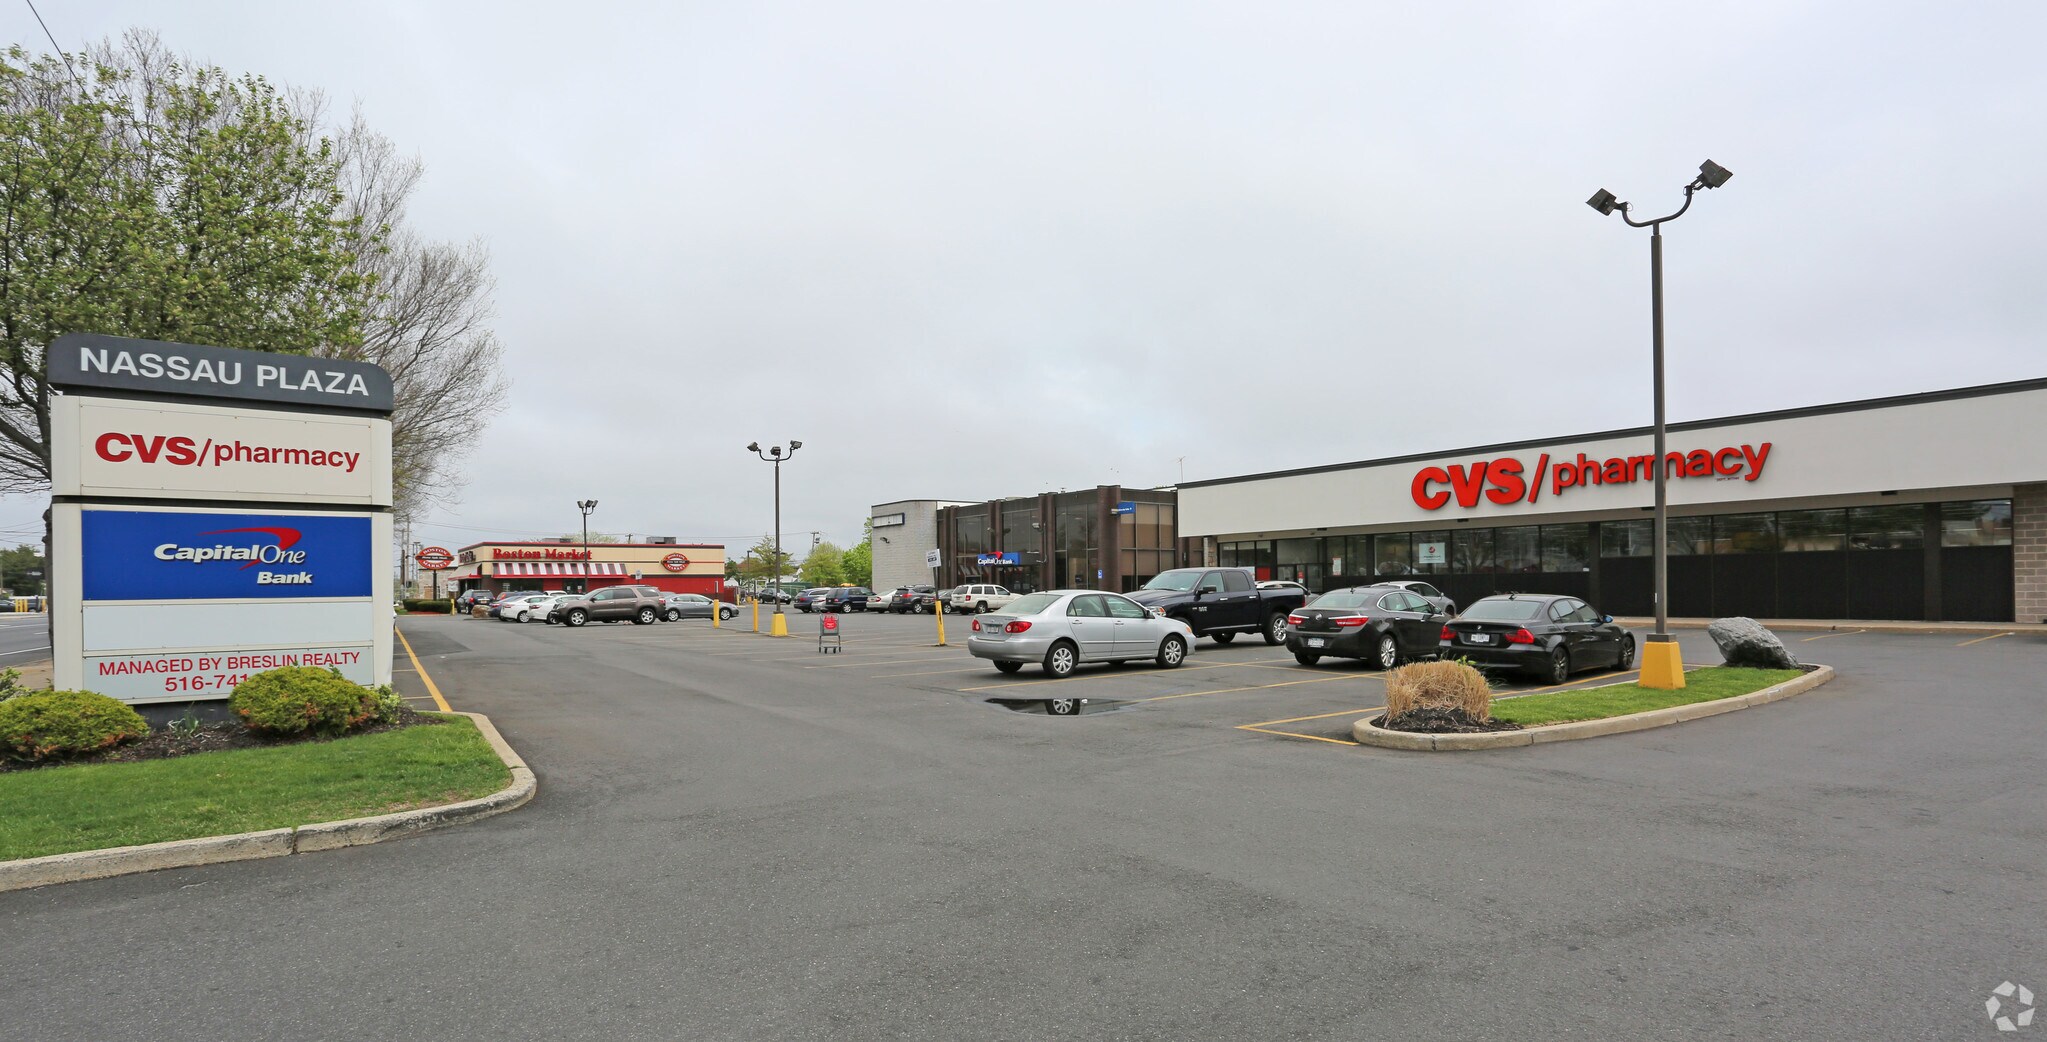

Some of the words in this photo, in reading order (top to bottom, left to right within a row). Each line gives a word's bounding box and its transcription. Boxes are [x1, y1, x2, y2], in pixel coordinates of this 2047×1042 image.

[80, 347, 242, 385] NASSAU
[256, 365, 369, 396] PLAZA
[95, 432, 360, 473] CVS/pharmacy
[492, 548, 541, 560] Boston
[545, 549, 592, 560] Market
[257, 571, 313, 584] Bank
[99, 658, 193, 676] MANAGED
[199, 657, 222, 671] BY
[227, 654, 298, 670] BRESLIN
[302, 651, 360, 666] REALTY
[164, 673, 248, 692] 516-741
